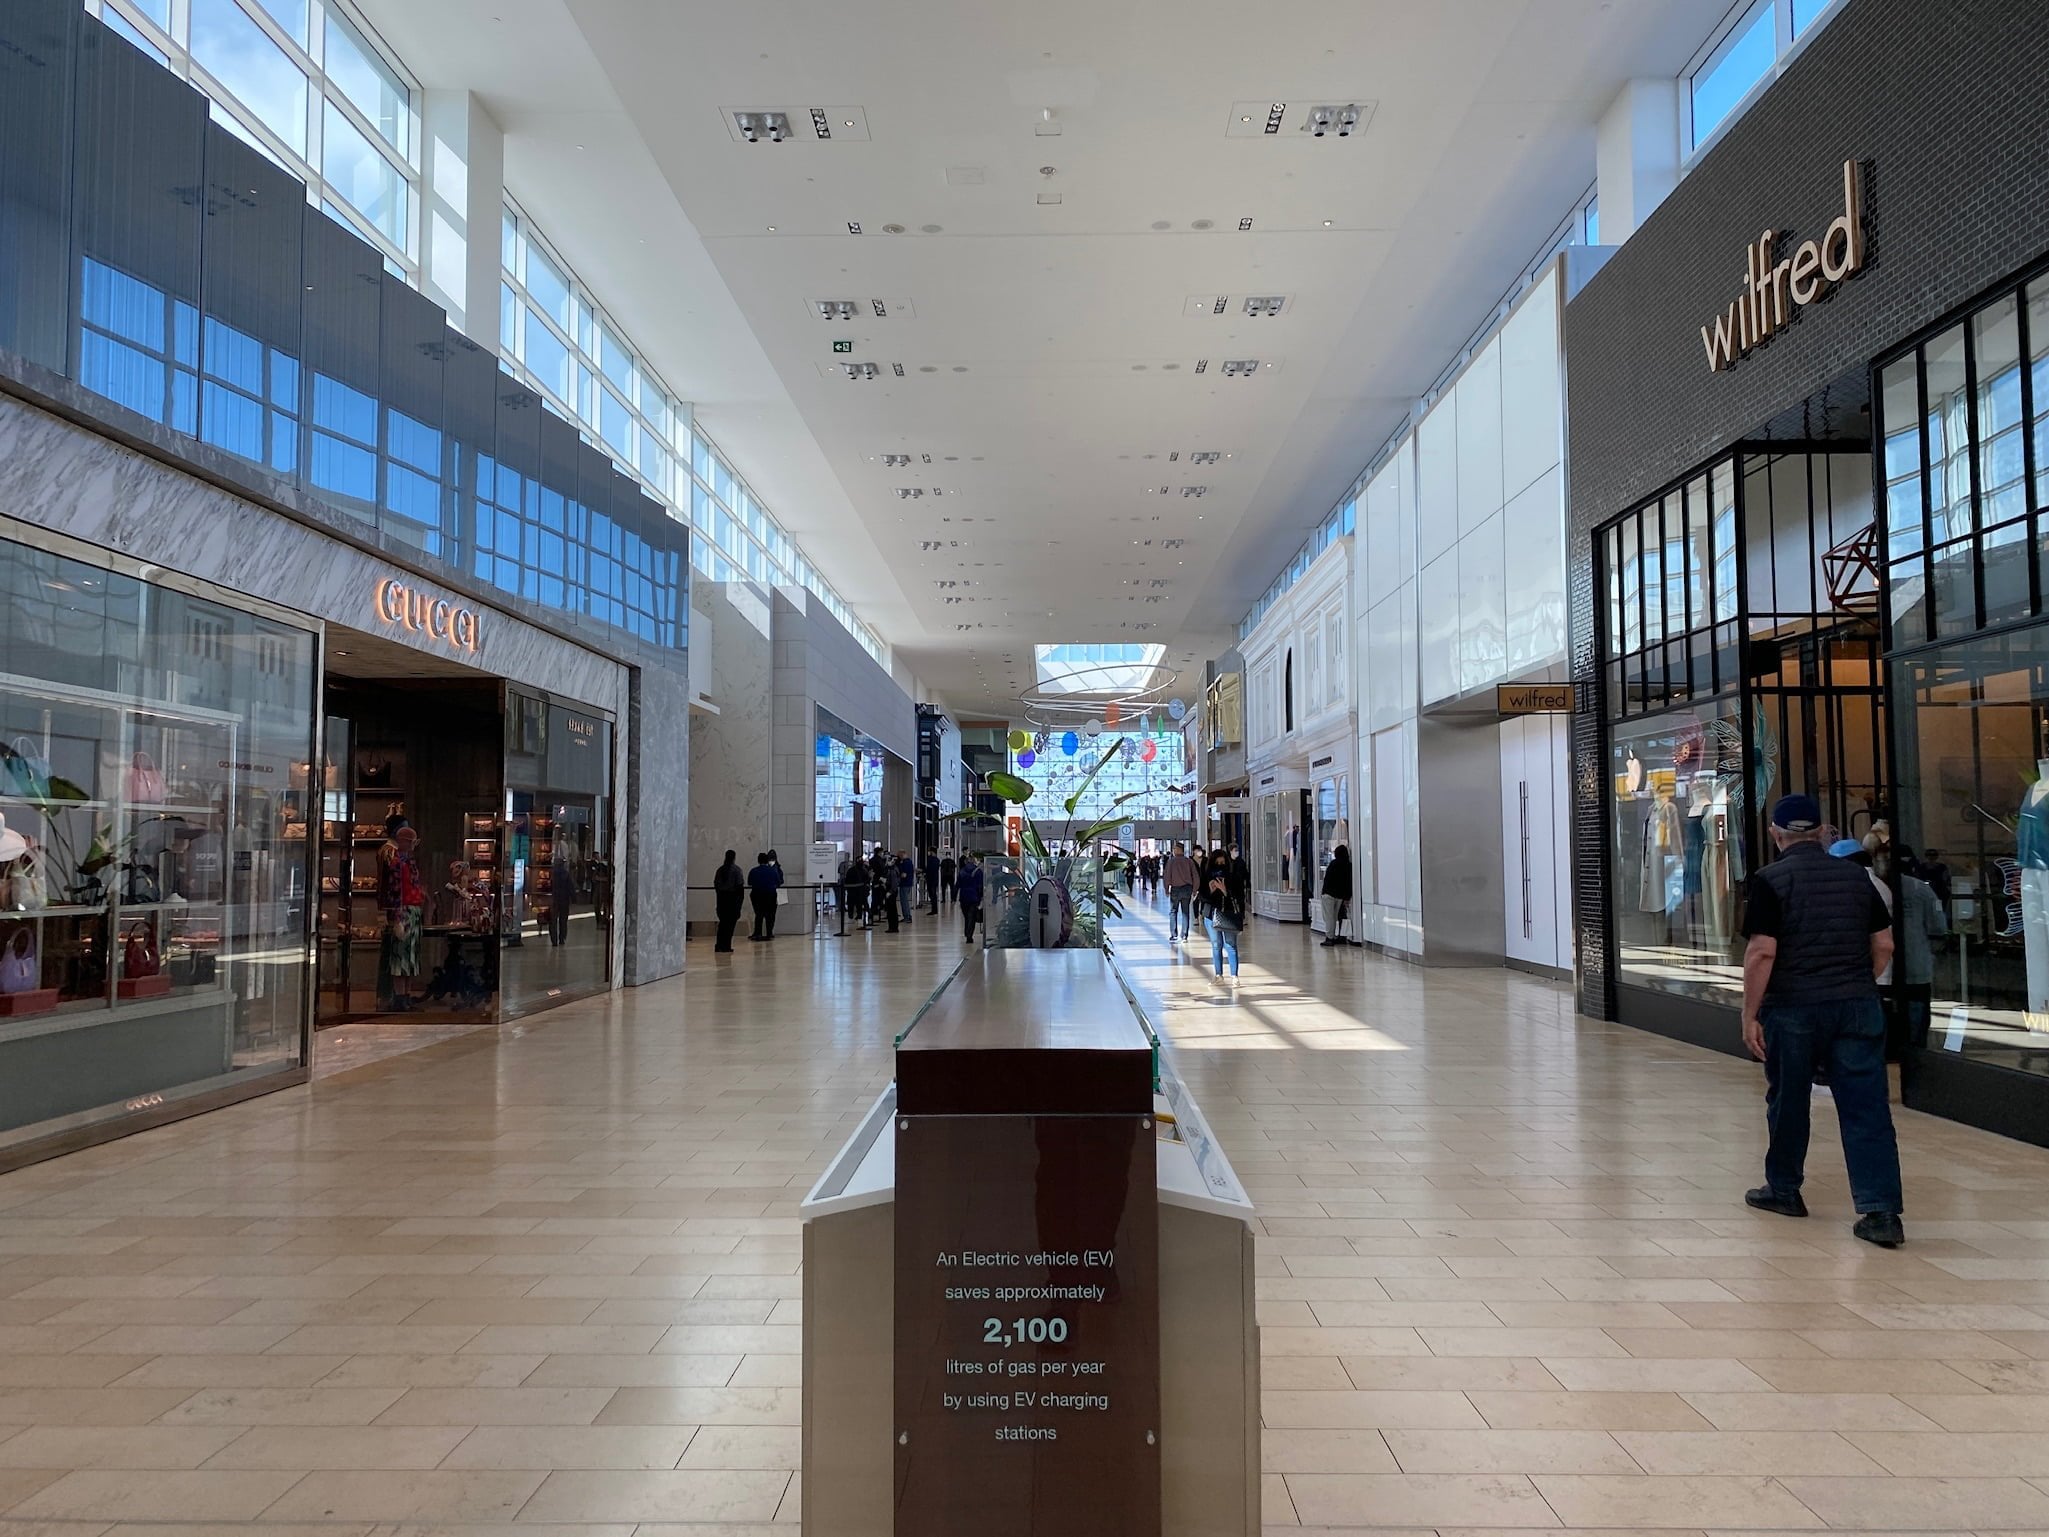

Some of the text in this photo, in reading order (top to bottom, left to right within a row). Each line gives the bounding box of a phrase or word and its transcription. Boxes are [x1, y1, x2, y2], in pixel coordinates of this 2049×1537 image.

[1701, 160, 1860, 372] wilfred
[378, 579, 481, 651] GUCCI
[1509, 689, 1566, 708] wilfred
[935, 1249, 1114, 1268] An Electric vehicle (EV)
[945, 1283, 1106, 1303] saves approximately
[983, 1317, 1068, 1349] 2,100
[946, 1358, 1106, 1378] litres of gas per year
[943, 1391, 1109, 1411] by using EV charging
[994, 1424, 1058, 1441] stations
